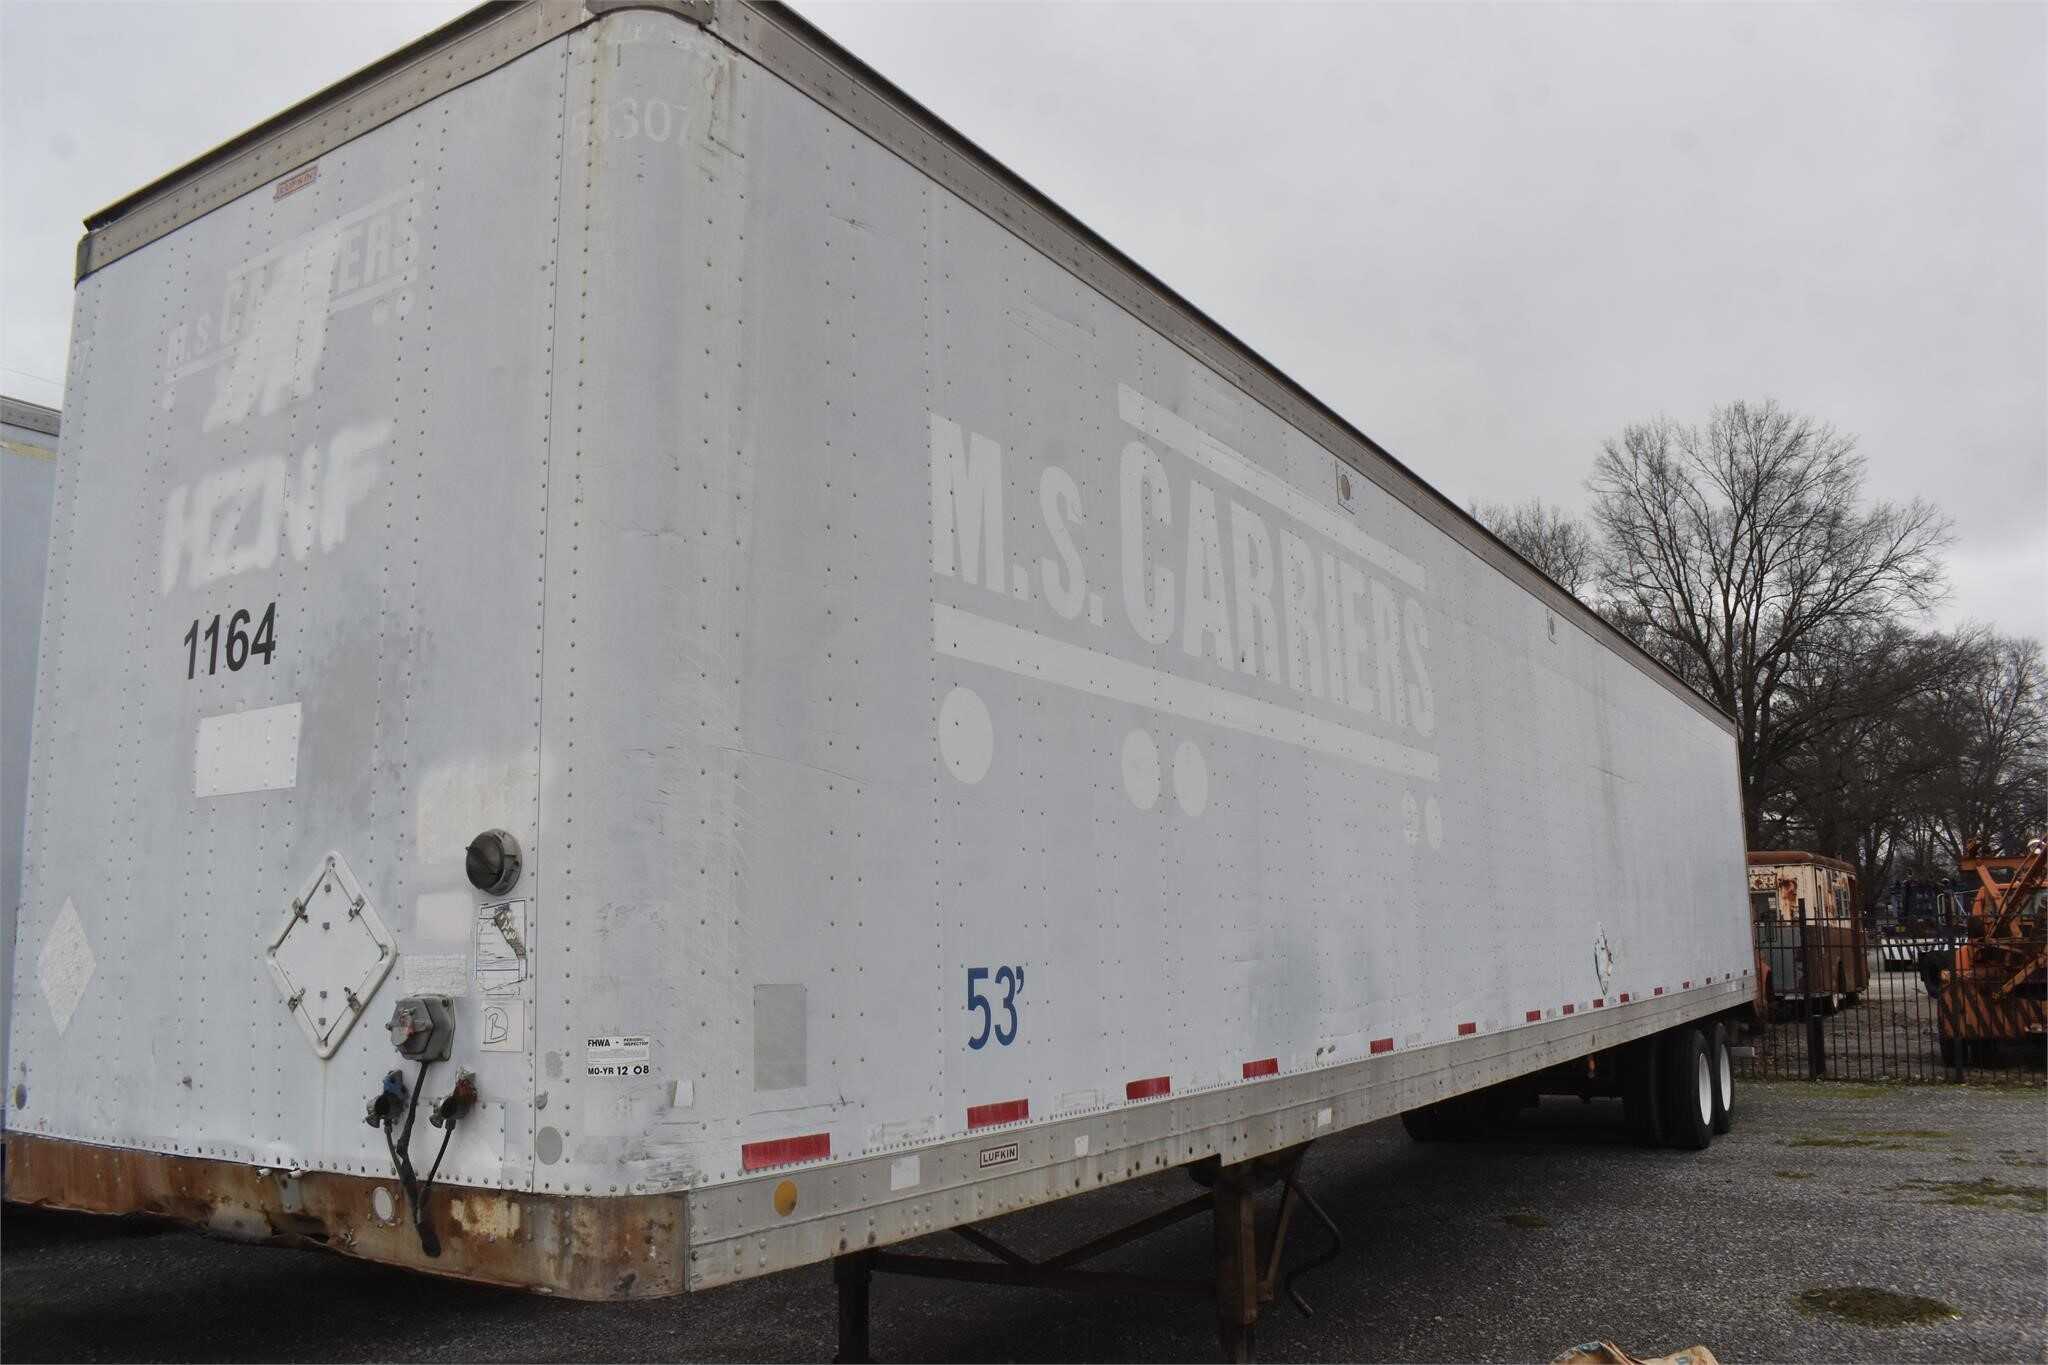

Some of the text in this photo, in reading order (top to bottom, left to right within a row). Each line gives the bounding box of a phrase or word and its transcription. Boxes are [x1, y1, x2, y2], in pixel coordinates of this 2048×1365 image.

[930, 415, 1436, 738] M.S. CARRIERS
[183, 602, 277, 680] 1164
[588, 1039, 611, 1048] FHWA
[617, 1066, 629, 1075] 12
[633, 1065, 650, 1075] 08
[982, 1147, 1016, 1163] LUFKIN
